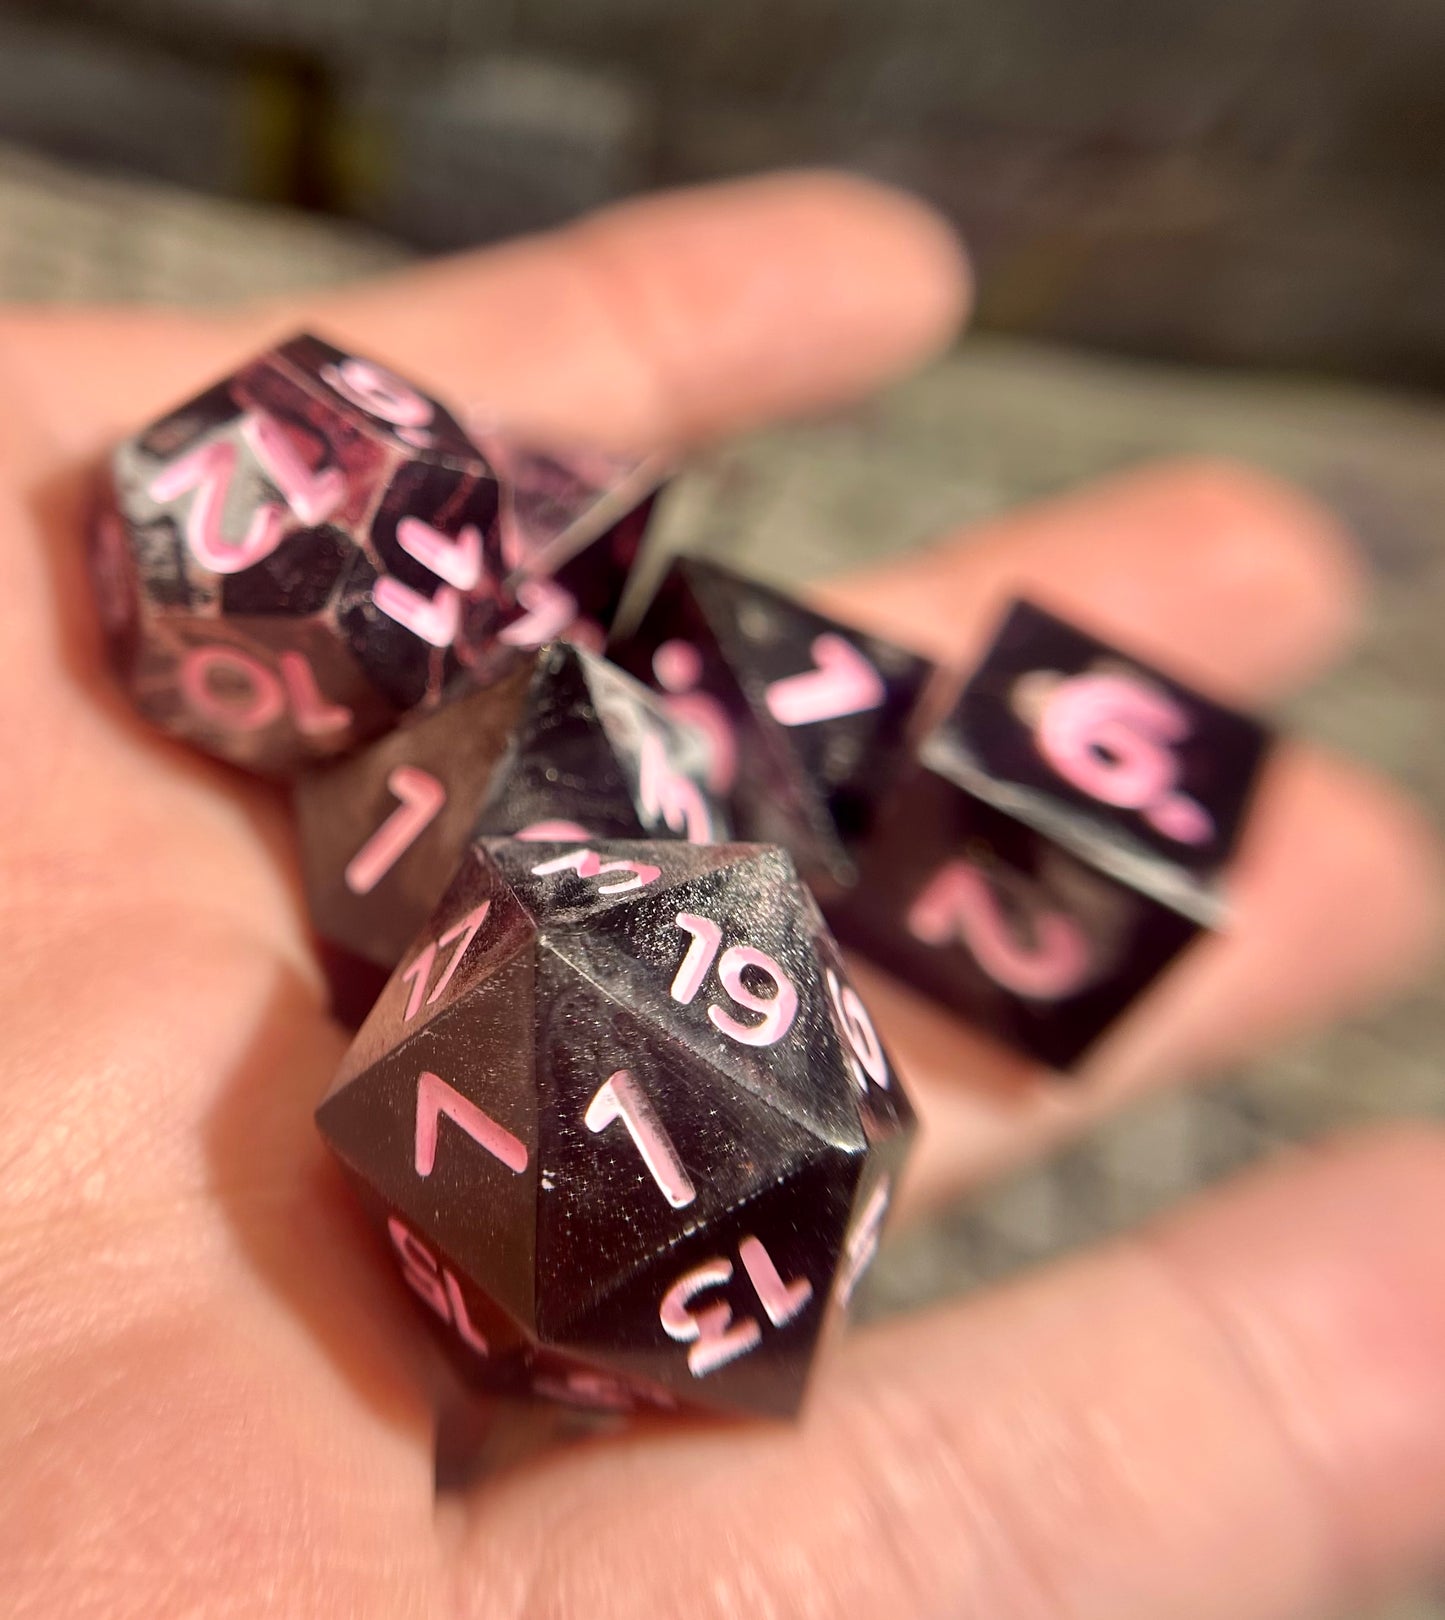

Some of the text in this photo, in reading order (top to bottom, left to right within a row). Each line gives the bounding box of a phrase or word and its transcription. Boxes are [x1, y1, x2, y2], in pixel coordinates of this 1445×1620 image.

[149, 411, 348, 574] 12
[180, 646, 354, 734] 10
[344, 762, 448, 897] 1
[402, 899, 491, 1022] 17
[670, 911, 798, 1046] 19
[904, 859, 1092, 1002] 2
[414, 1070, 528, 1177] 7
[584, 1069, 696, 1209] 1
[659, 1234, 813, 1378] 13
